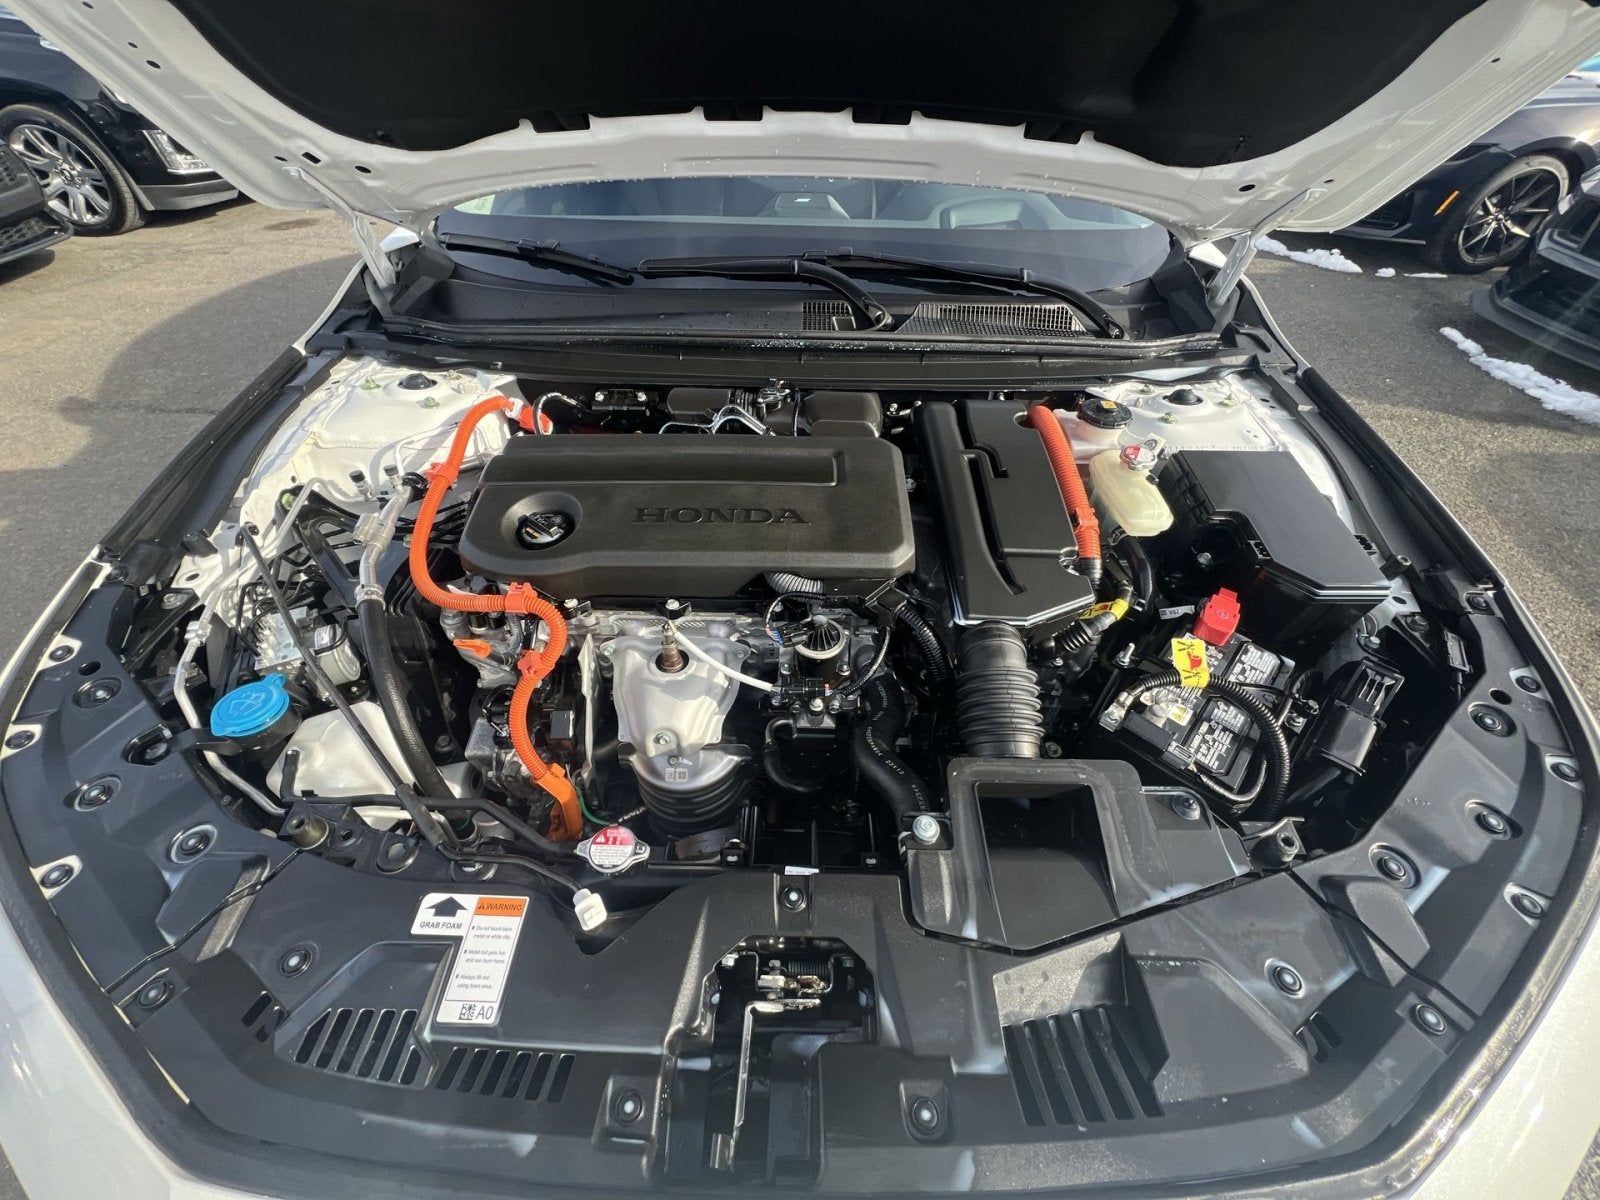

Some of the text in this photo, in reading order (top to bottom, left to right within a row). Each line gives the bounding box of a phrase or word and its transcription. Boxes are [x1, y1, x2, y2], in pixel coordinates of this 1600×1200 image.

[630, 507, 810, 524] HONDA
[486, 903, 522, 911] WARNING
[419, 921, 462, 930] GRAB FOAM
